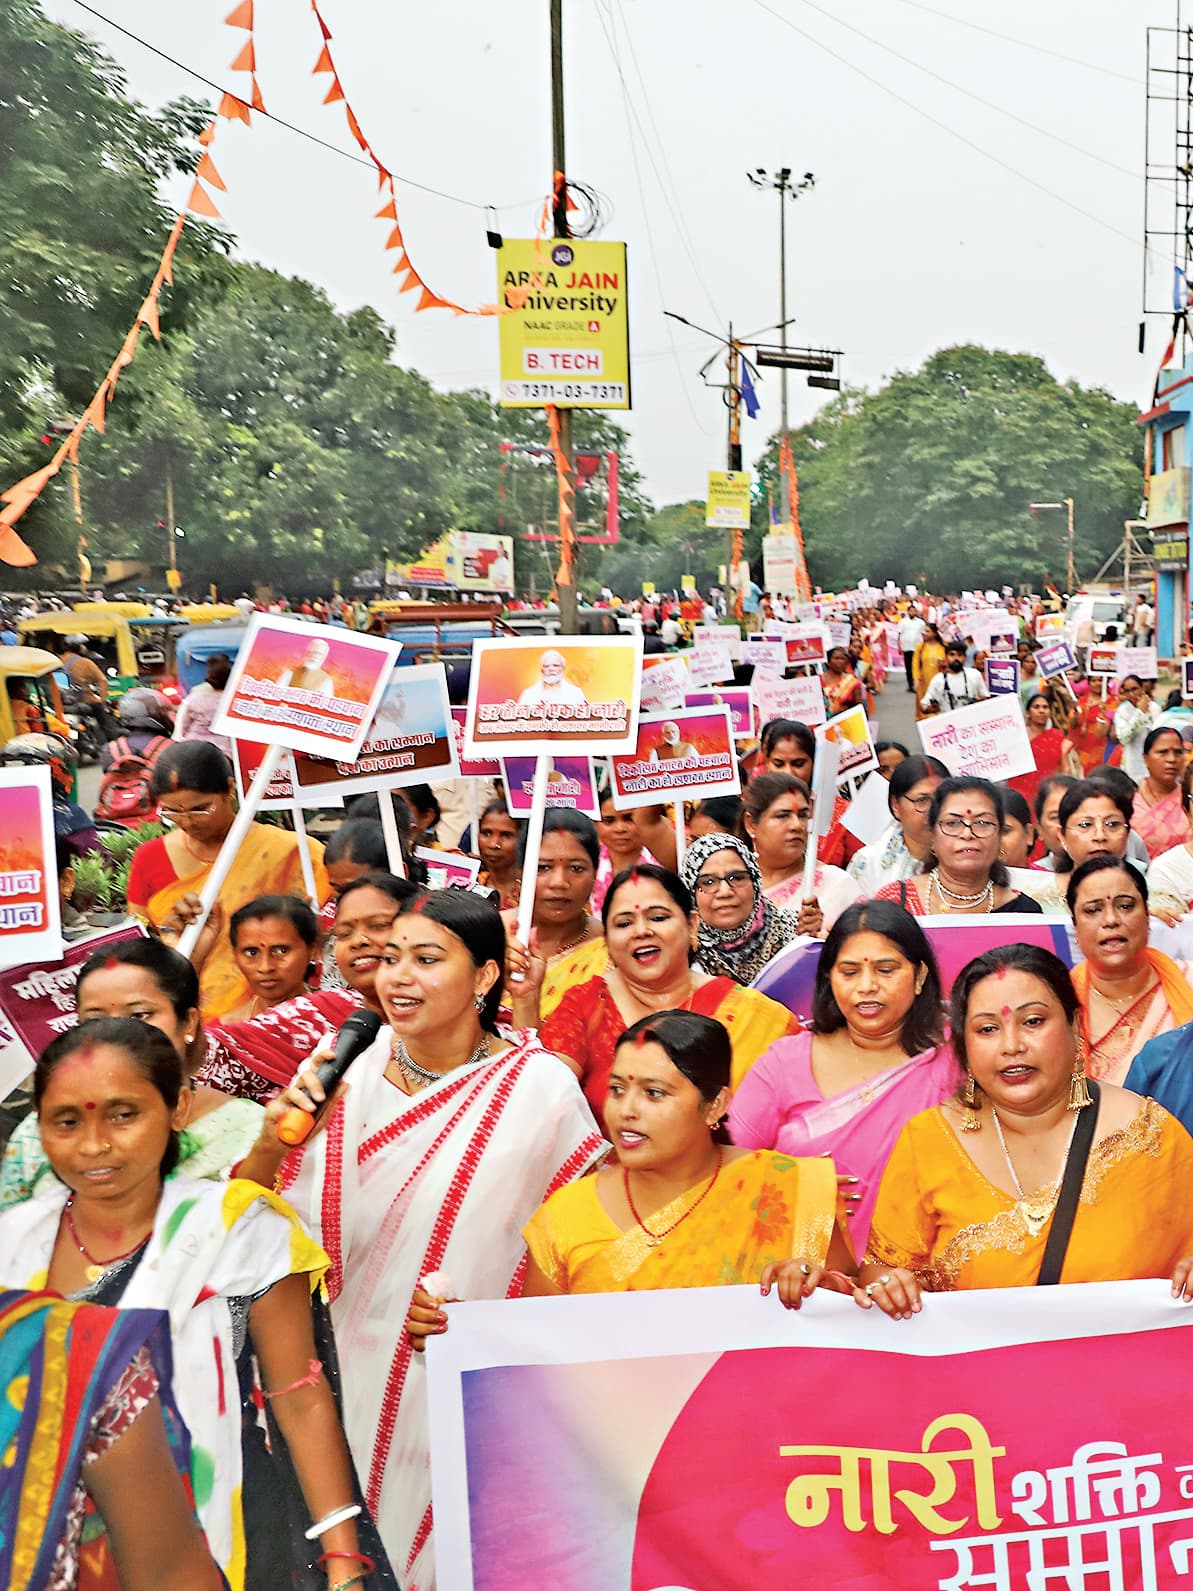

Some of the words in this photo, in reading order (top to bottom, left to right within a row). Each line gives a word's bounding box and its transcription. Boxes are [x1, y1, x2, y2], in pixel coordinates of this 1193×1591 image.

[565, 272, 619, 290] JAIN
[527, 353, 545, 369] B.
[550, 353, 600, 370] TECH
[521, 383, 624, 400] 7371-03-7371
[479, 703, 500, 720] हर
[500, 699, 530, 719] तीन
[549, 702, 574, 718] एक
[591, 699, 627, 718] नारी
[374, 739, 390, 752] का
[390, 732, 436, 750] सम्मान
[930, 723, 959, 749] नारी
[959, 726, 976, 740] का
[981, 738, 998, 753] का
[360, 759, 378, 772] का
[619, 761, 658, 776] विकसित
[684, 755, 698, 769] की
[698, 753, 730, 766] पहचान
[625, 776, 648, 792] नारी
[648, 778, 662, 788] का
[780, 1413, 1006, 1535] नारी
[1010, 1441, 1163, 1527] शक्ति
